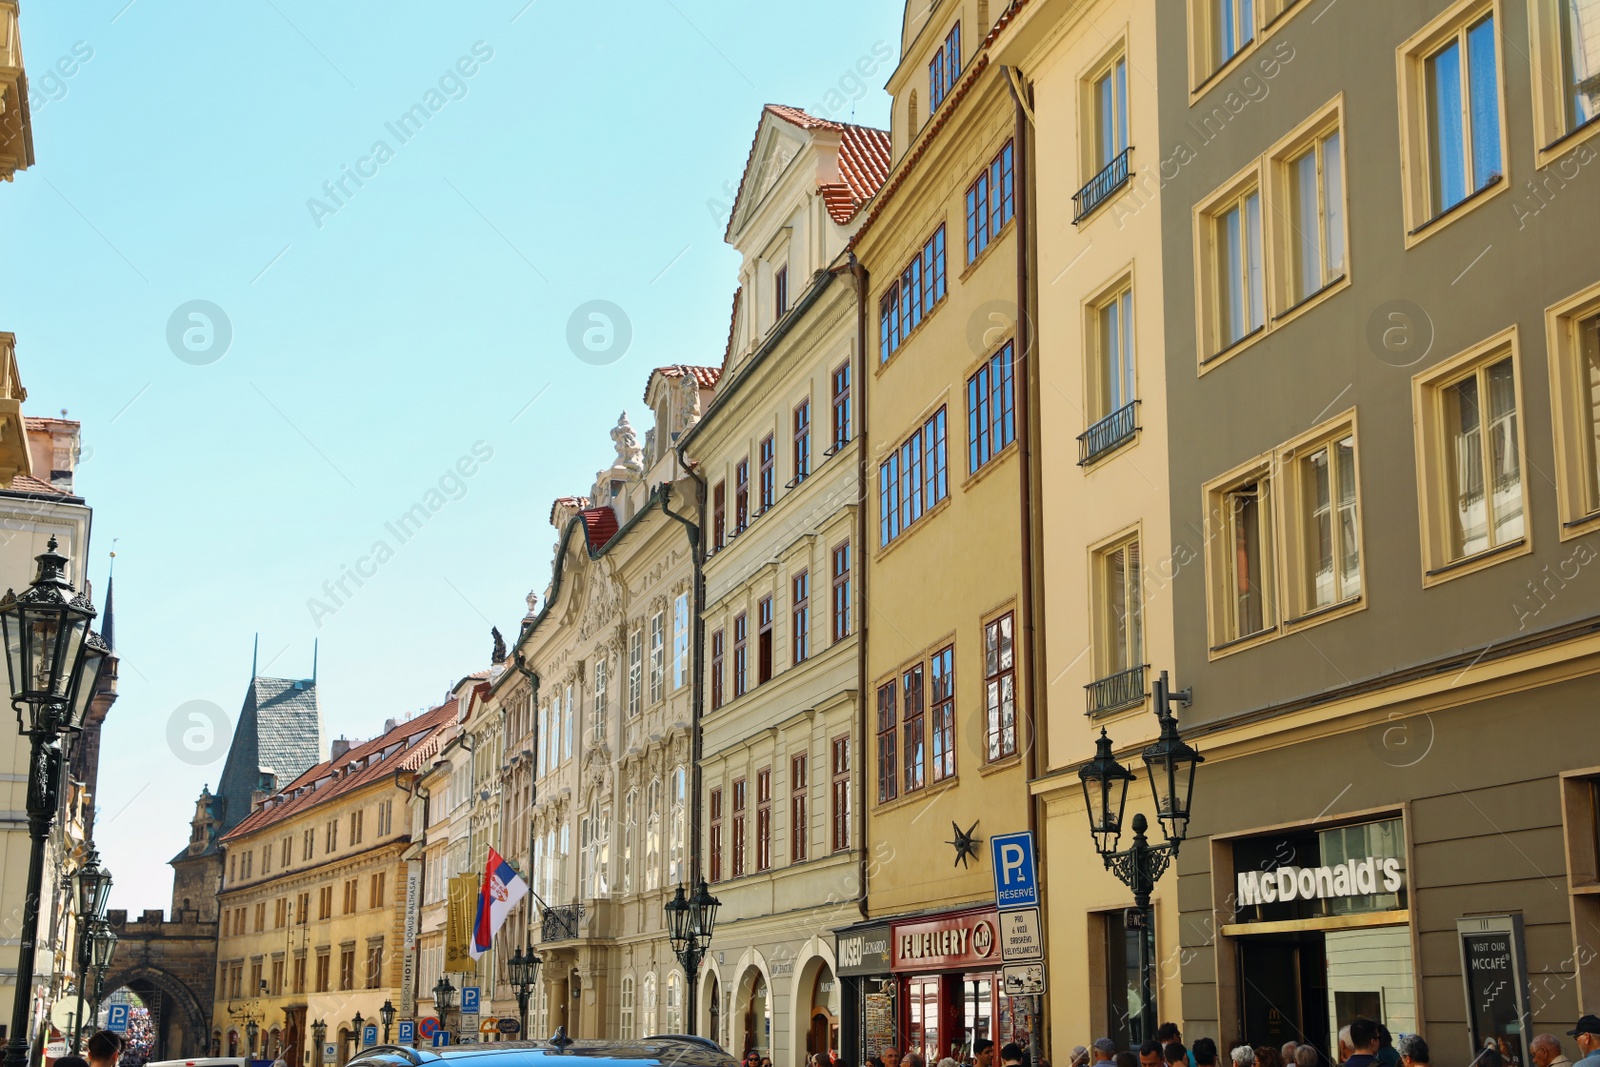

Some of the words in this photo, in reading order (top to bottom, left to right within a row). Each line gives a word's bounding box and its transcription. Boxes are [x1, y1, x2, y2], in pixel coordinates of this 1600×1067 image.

[1001, 843, 1025, 885] P
[1238, 857, 1401, 906] McDonald's
[999, 886, 1034, 900] RÉSERVÉ
[1014, 915, 1024, 924] PRO
[406, 916, 414, 943] DOMUS
[899, 928, 968, 960] JEWELLERY
[1472, 943, 1489, 952] VISIT
[1491, 942, 1506, 951] OUR
[839, 937, 862, 967] MUSEO
[465, 990, 476, 1005] P
[112, 1007, 125, 1023] P
[366, 1029, 375, 1039] P
[402, 1025, 411, 1036] P
